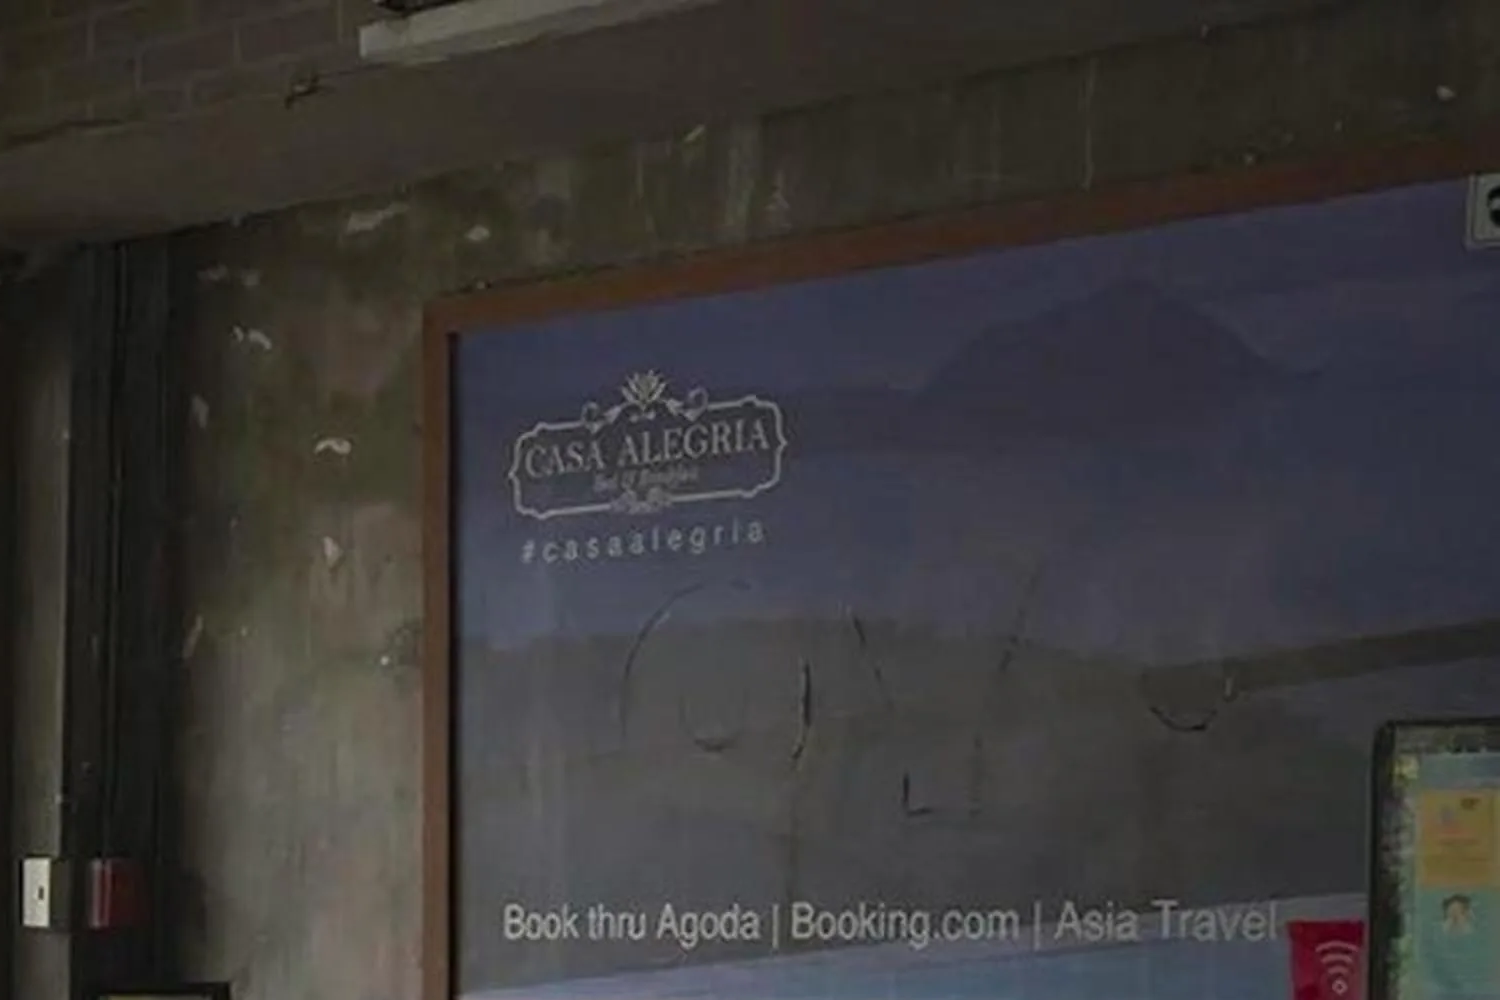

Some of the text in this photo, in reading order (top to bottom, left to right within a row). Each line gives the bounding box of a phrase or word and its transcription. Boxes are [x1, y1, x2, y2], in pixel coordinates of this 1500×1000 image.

[524, 418, 770, 479] CASA ALEGRIA
[521, 520, 764, 563] #casaalegria
[503, 903, 580, 940] Book
[588, 903, 647, 940] thru
[656, 903, 761, 949] Agoda
[791, 901, 1020, 950] Booking.com
[1054, 902, 1140, 941] Asia
[1152, 901, 1278, 942] Travel
